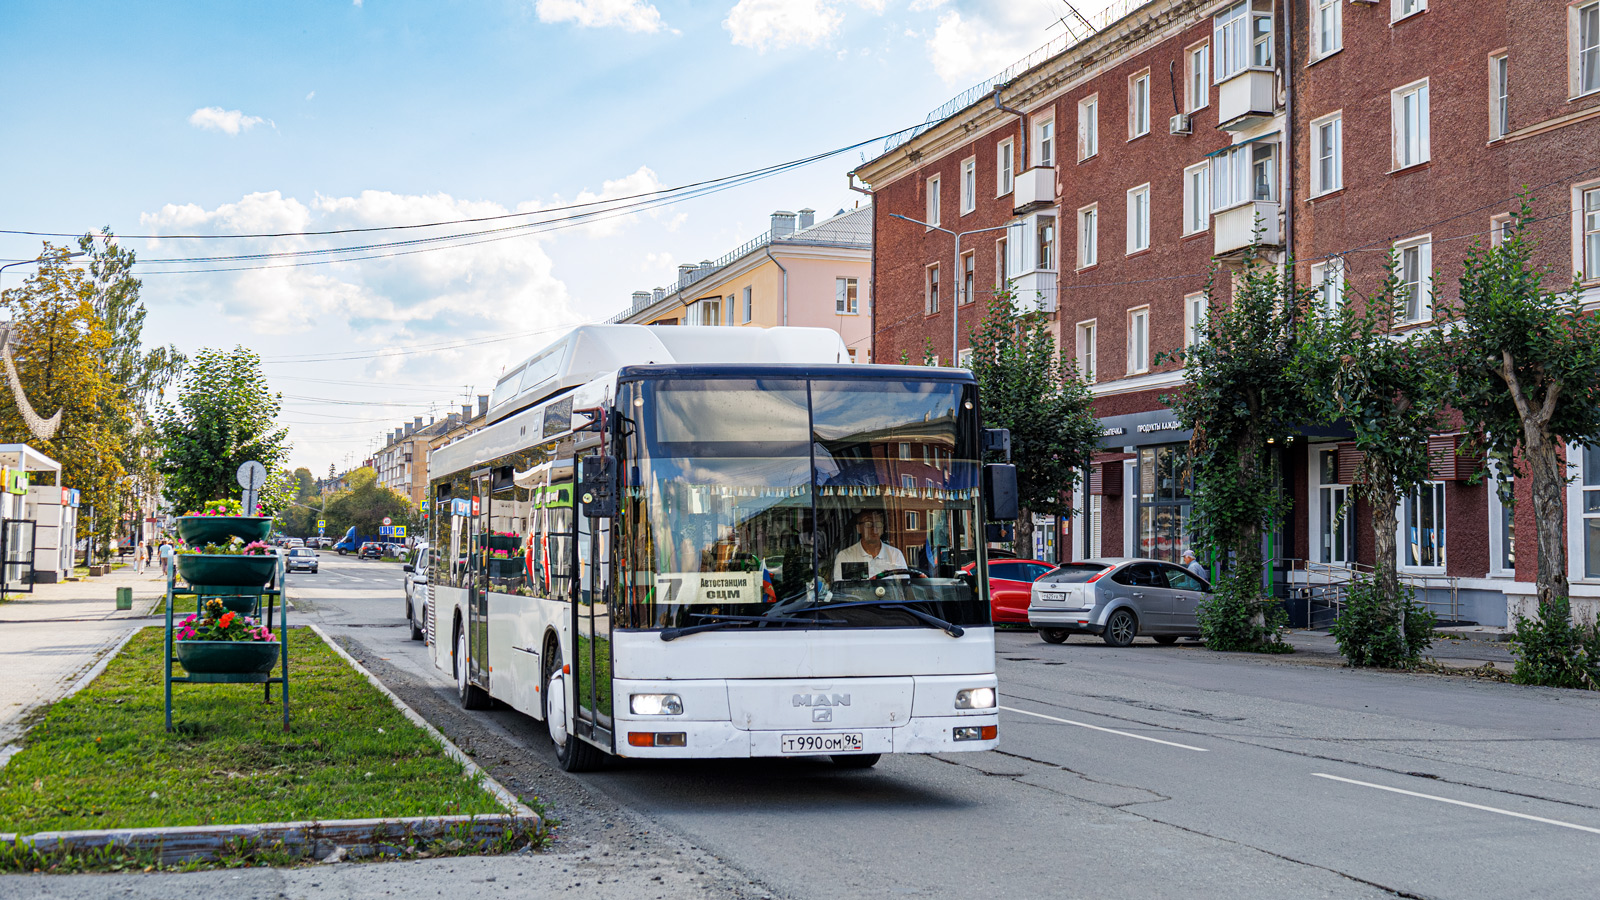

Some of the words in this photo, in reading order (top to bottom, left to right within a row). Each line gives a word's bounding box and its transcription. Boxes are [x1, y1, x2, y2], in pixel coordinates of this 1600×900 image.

[1137, 422, 1160, 433] ПРОДУКТЫ
[1161, 420, 1182, 431] КАЖДЫ
[658, 578, 683, 601] 7
[700, 578, 748, 588] Автостанция
[792, 693, 851, 707] MAN
[788, 736, 842, 750] Т990ОМ
[845, 735, 858, 745] 96
